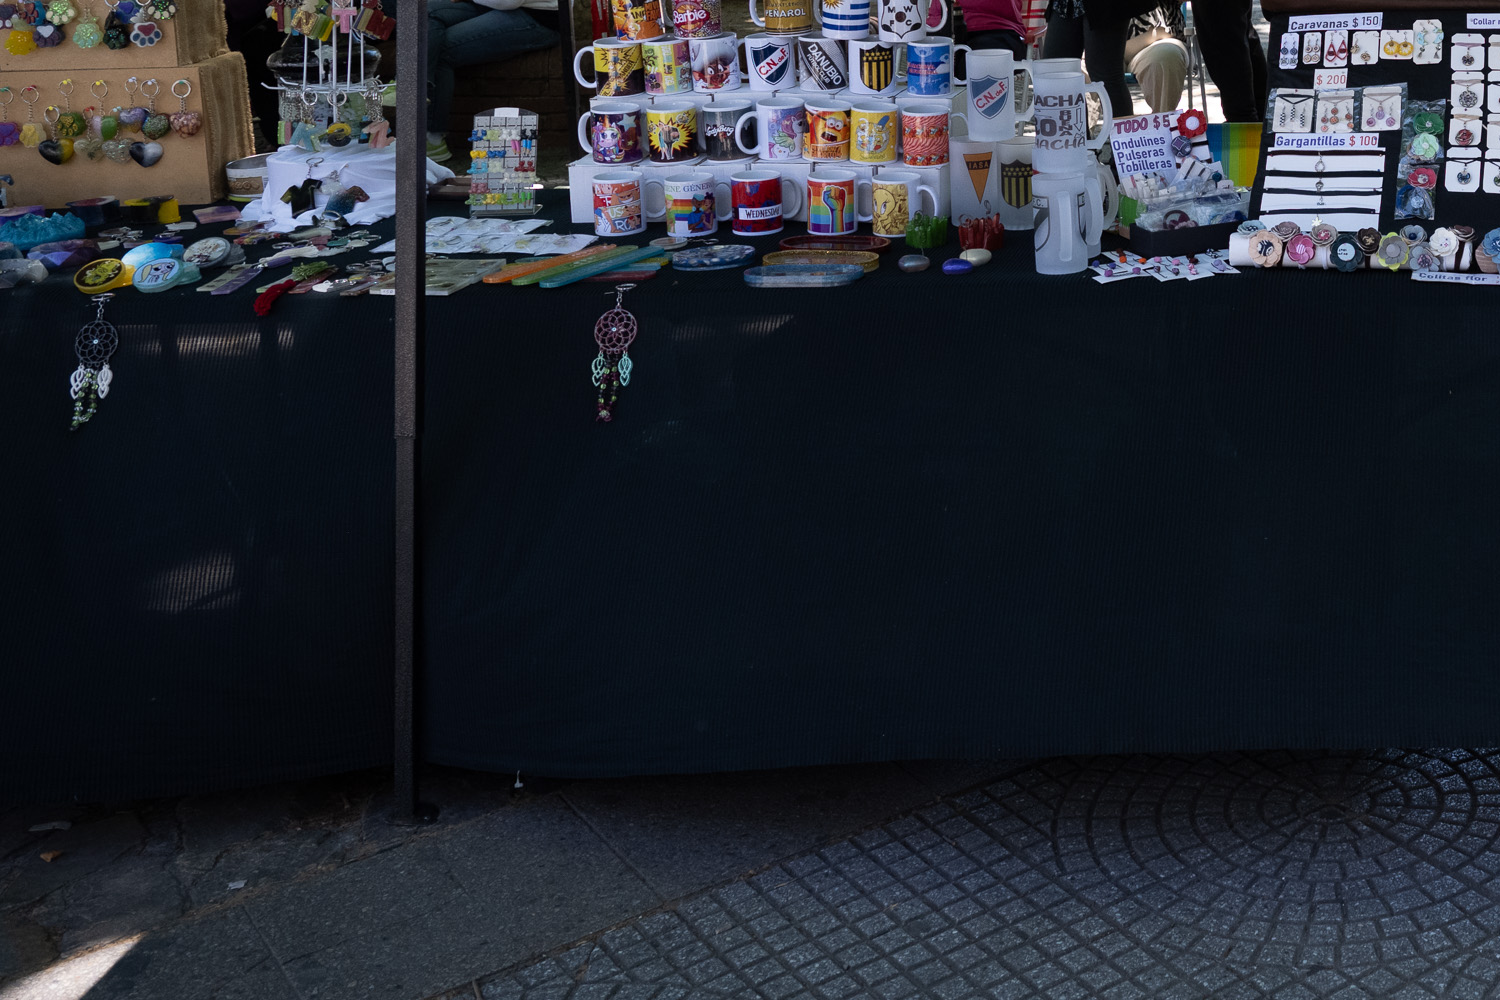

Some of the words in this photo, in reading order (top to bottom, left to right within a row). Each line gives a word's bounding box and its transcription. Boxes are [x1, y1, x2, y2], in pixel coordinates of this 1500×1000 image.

[672, 8, 707, 23] Barbie
[765, 8, 806, 18] PEÑAROL
[887, 6, 896, 14] M
[903, 5, 913, 13] W
[1290, 20, 1349, 31] Caravanas
[1352, 17, 1359, 28] $
[1361, 15, 1379, 26] 150
[1473, 18, 1496, 26] Collar
[807, 43, 842, 85] DANUBIO
[1316, 74, 1323, 86] $
[1326, 74, 1346, 85] 200
[1034, 92, 1084, 107] ACHA
[1114, 117, 1149, 135] TODO
[1112, 136, 1166, 151] Ondulines
[1276, 135, 1346, 148] Gargantillas
[1349, 135, 1356, 147] $
[1359, 135, 1378, 146] 100
[1117, 148, 1165, 162] Pulseras
[968, 161, 989, 170] IASA
[1118, 160, 1173, 174] Tobilleras
[1418, 272, 1461, 281] Colitas
